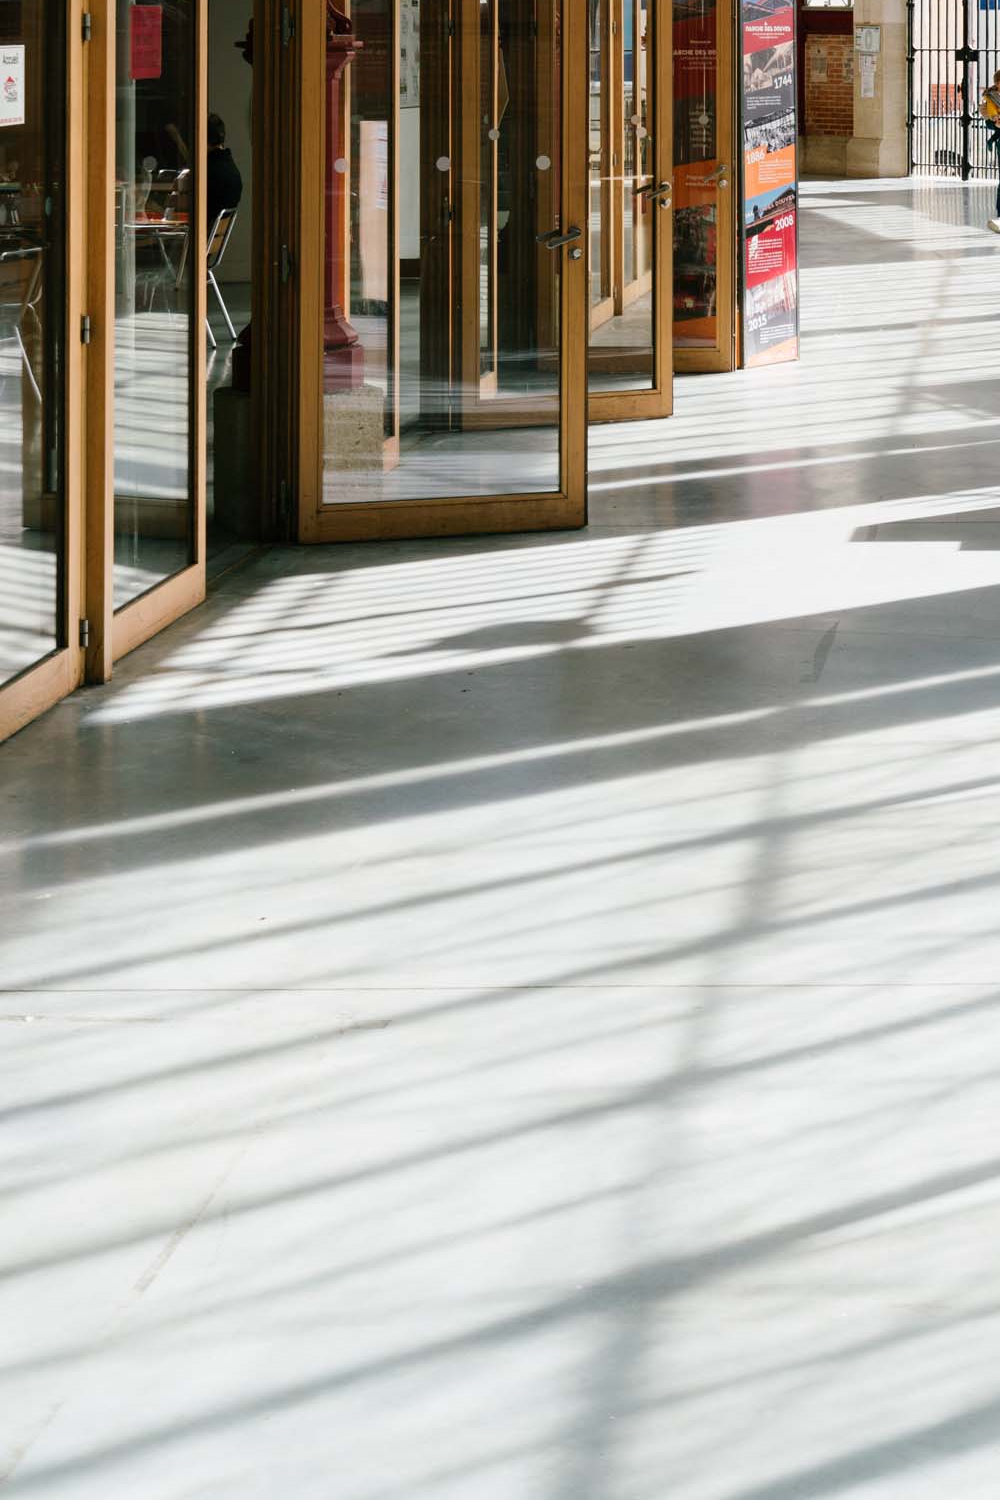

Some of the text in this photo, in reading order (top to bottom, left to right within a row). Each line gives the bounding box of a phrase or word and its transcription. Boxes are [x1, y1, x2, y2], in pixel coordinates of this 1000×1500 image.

[774, 74, 792, 89] 1744
[775, 214, 794, 231] 2008
[748, 314, 768, 332] 2015
